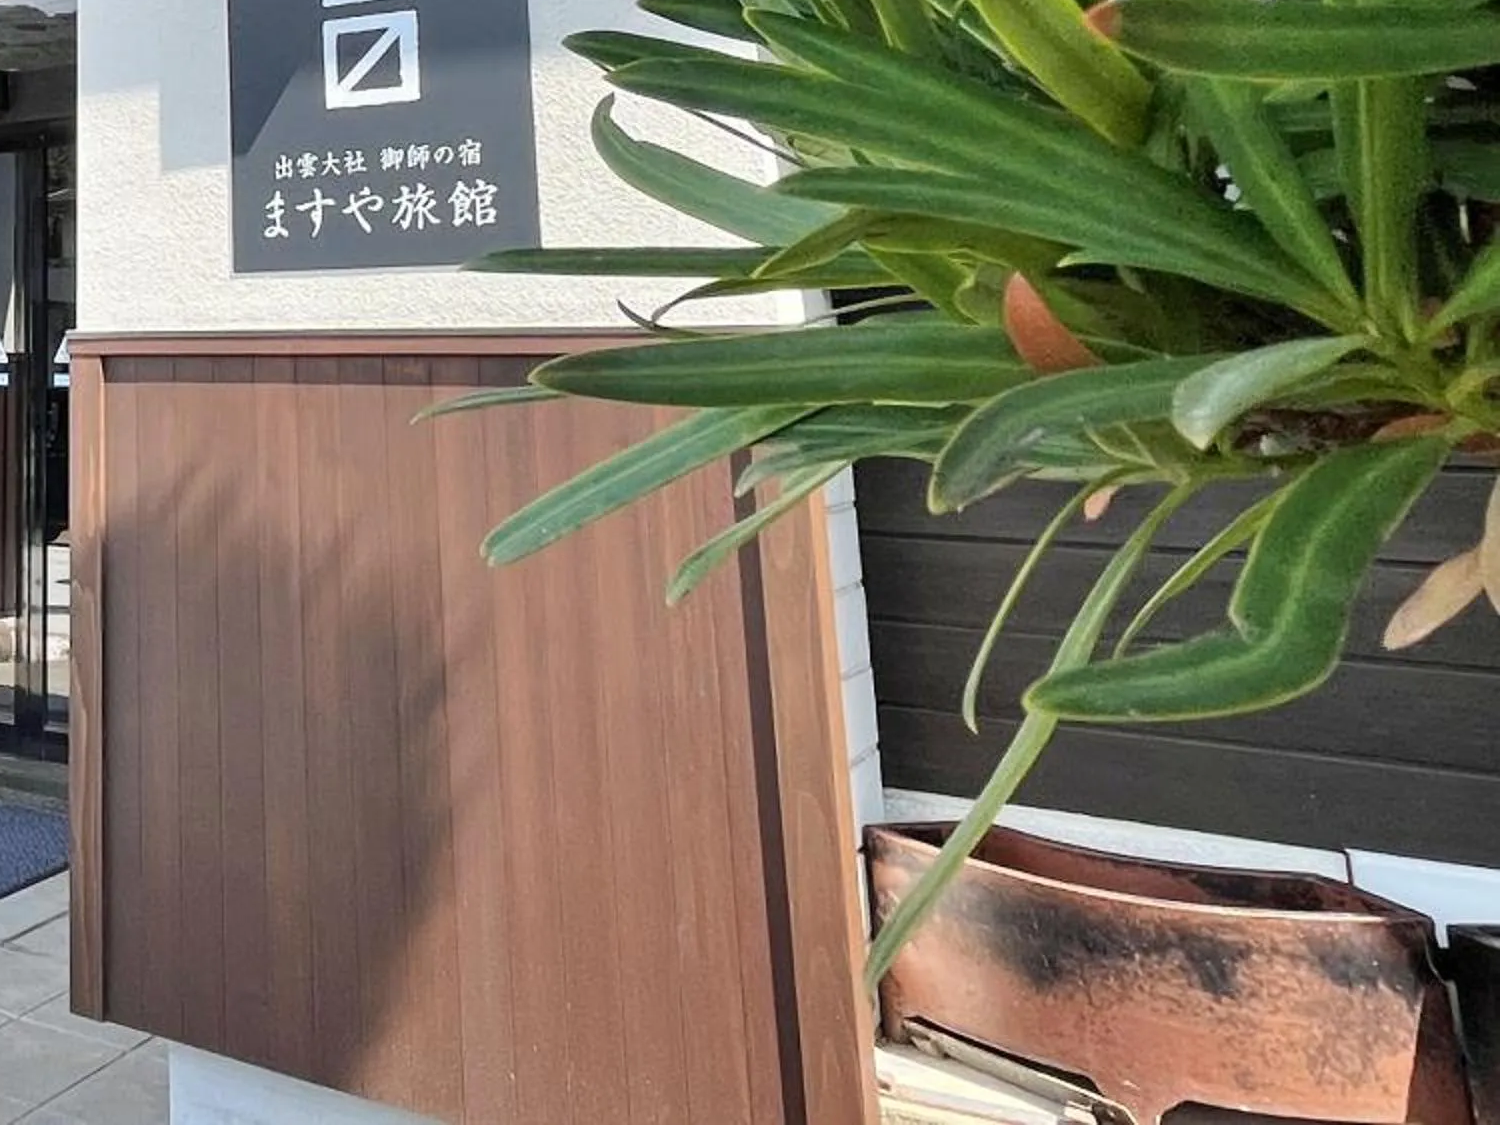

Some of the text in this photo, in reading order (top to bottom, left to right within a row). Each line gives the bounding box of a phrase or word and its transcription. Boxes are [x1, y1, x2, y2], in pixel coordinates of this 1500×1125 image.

[274, 138, 482, 180] 出雲大社 御師の宿
[263, 178, 498, 239] ますや旅館
